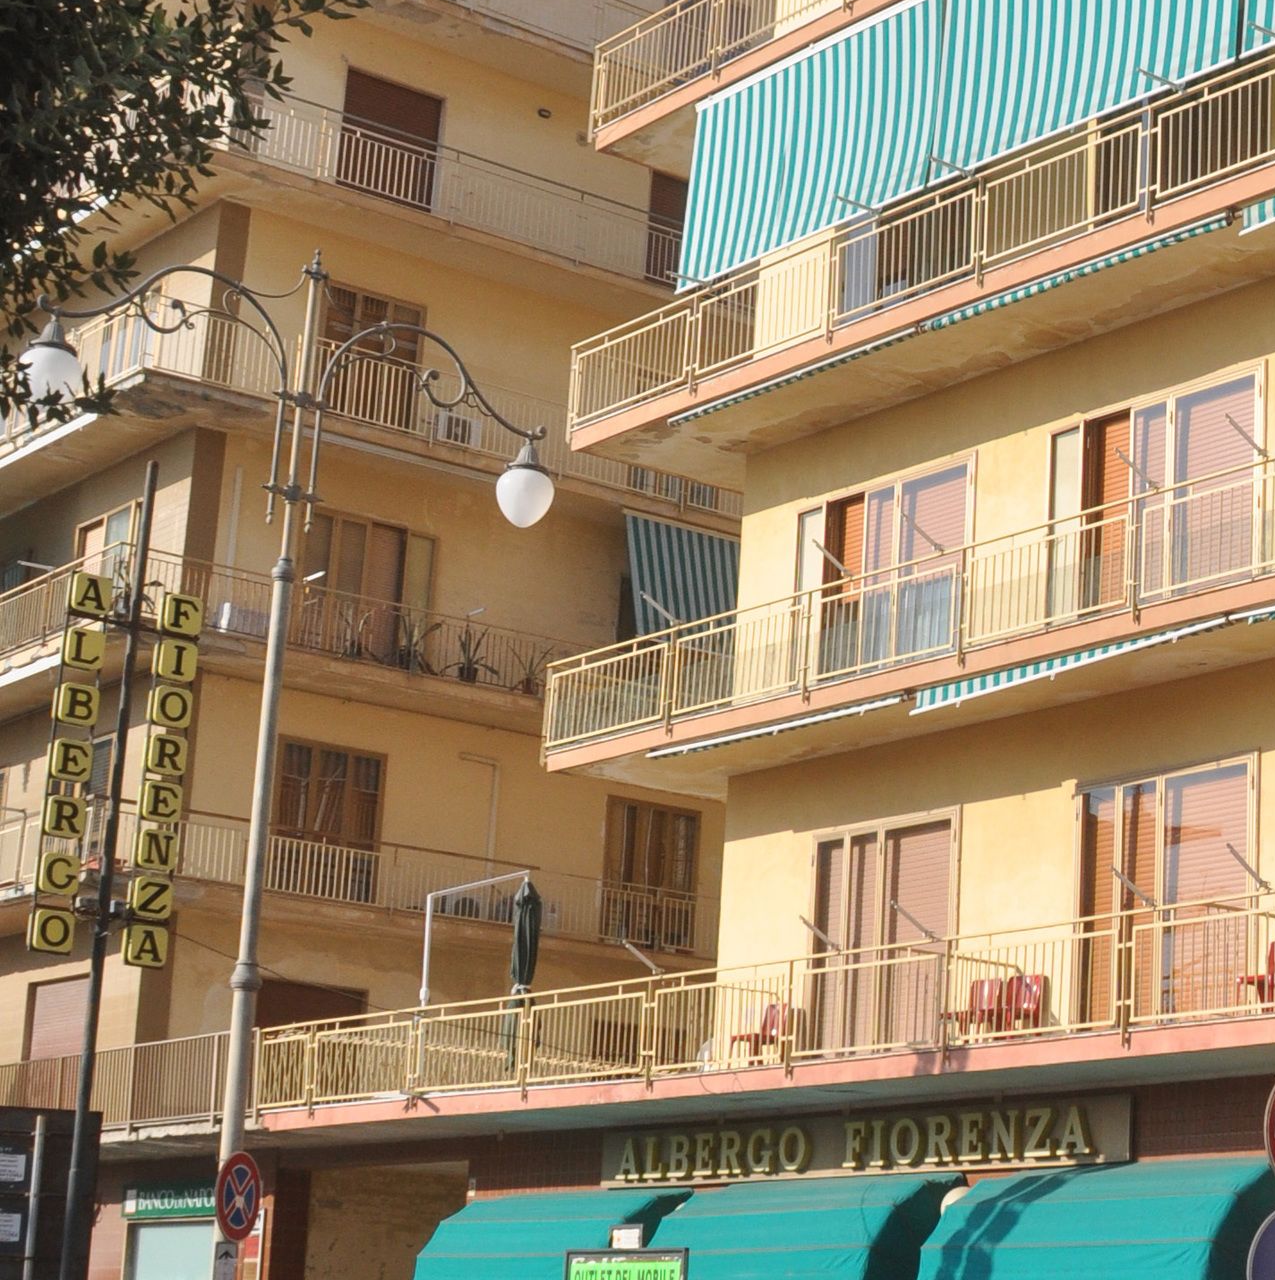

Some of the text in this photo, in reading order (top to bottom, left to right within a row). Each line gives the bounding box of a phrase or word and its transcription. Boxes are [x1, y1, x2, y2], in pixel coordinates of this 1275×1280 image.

[40, 578, 106, 948] ALBERGO
[133, 598, 200, 963] FIORENZA
[138, 1190, 174, 1211] BANCO
[183, 1187, 216, 1208] NAPO
[615, 1104, 1093, 1181] ALBERGO FIORENZA
